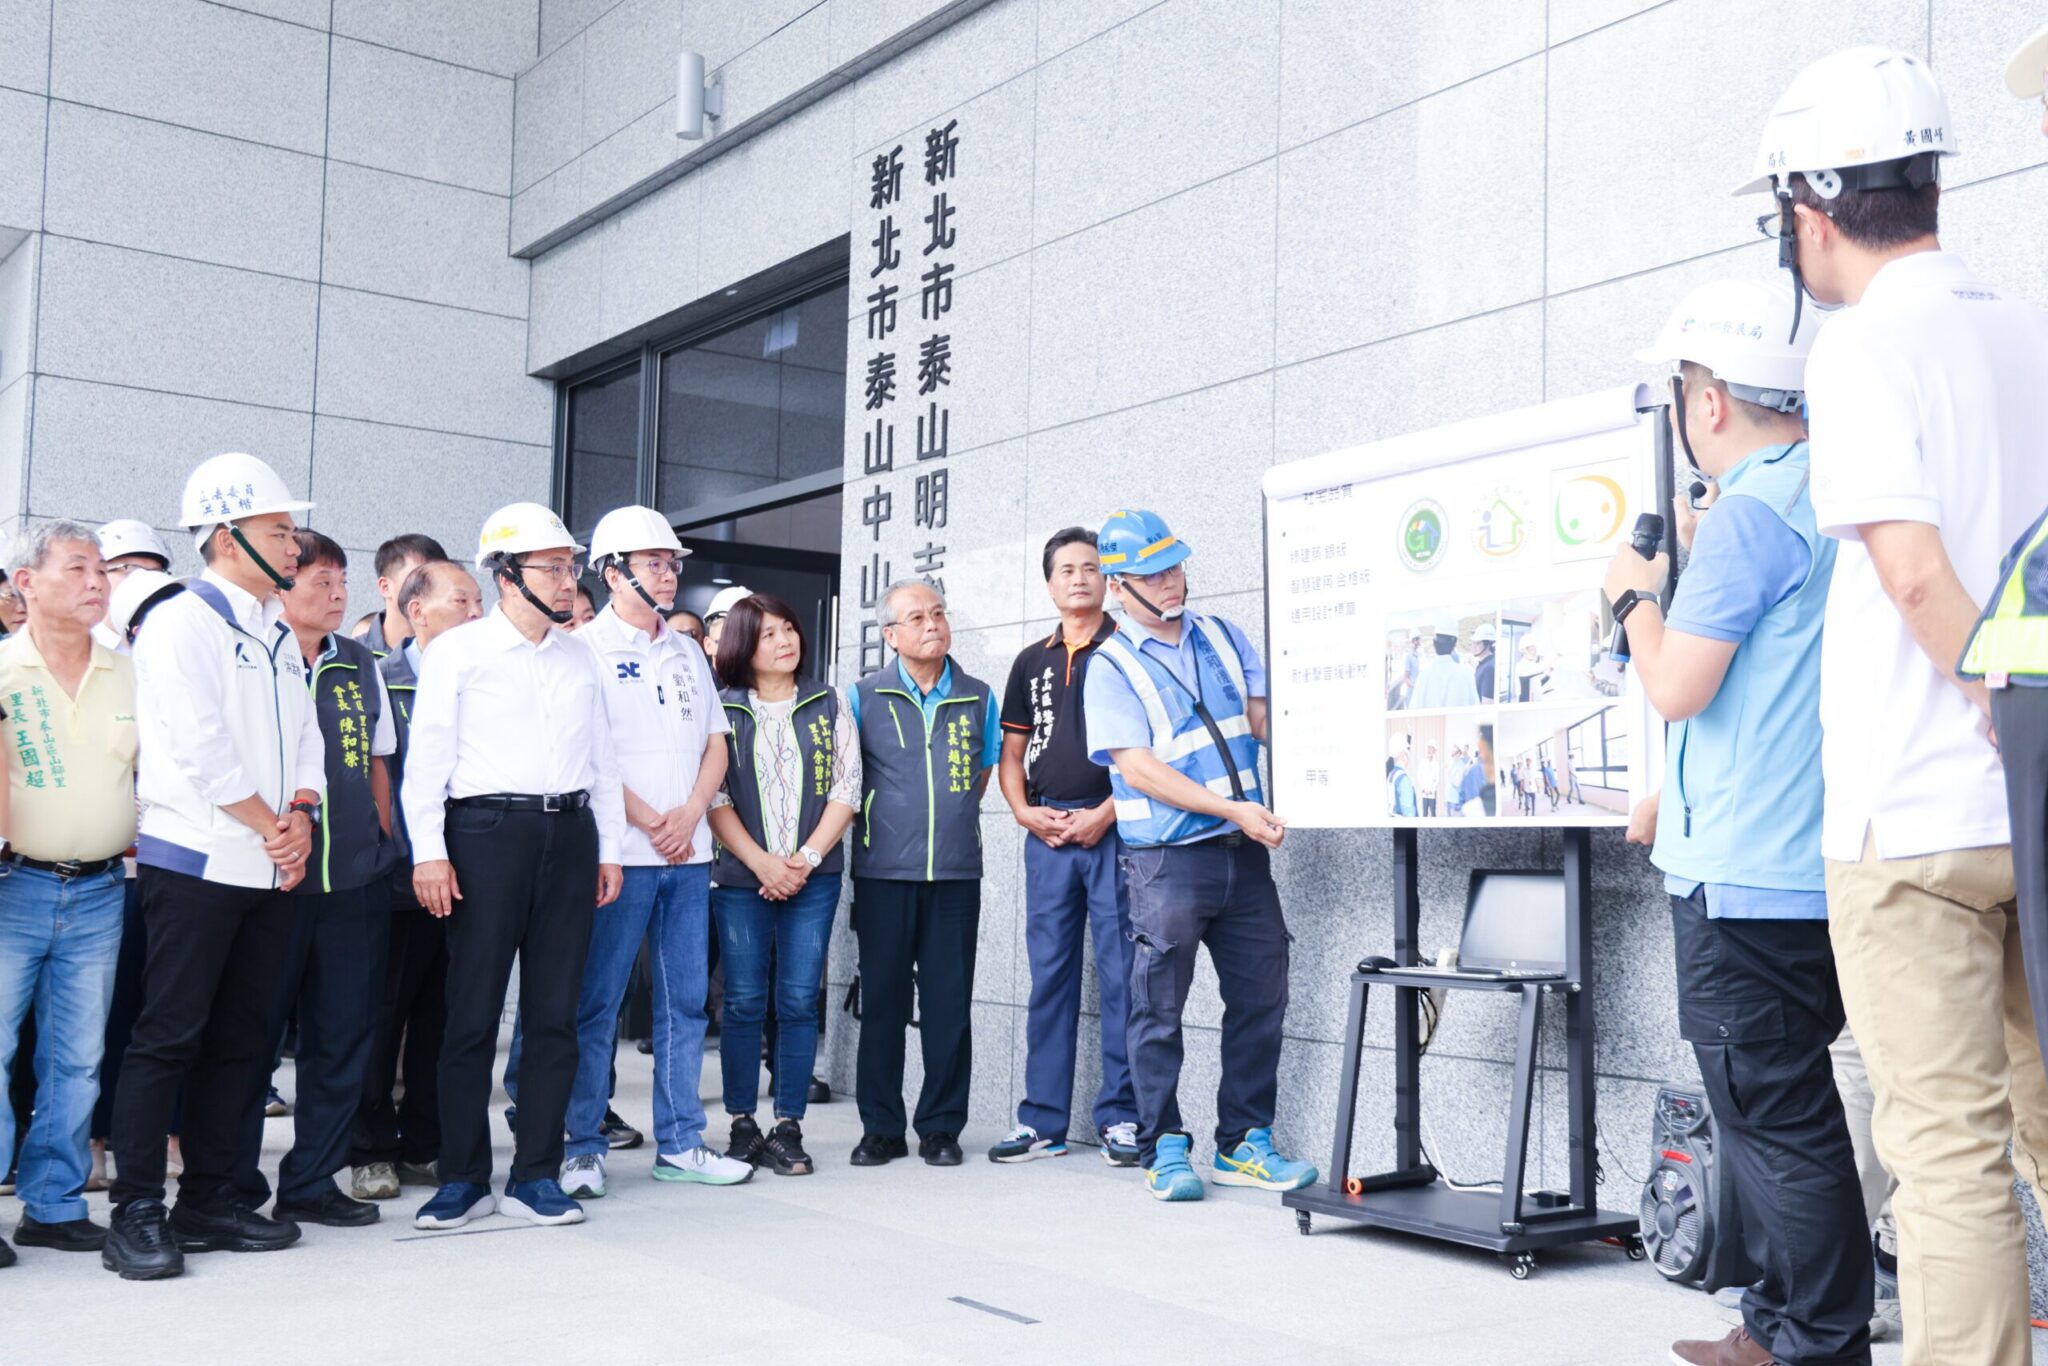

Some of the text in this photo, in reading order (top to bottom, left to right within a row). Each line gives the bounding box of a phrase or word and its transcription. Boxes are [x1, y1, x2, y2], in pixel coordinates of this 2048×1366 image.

[913, 119, 960, 595] 新北市泰山明志
[860, 144, 904, 678] 新北市泰山中山日
[10, 692, 46, 788] 里長 王國超
[808, 723, 823, 745] 里長
[947, 722, 960, 746] 里長
